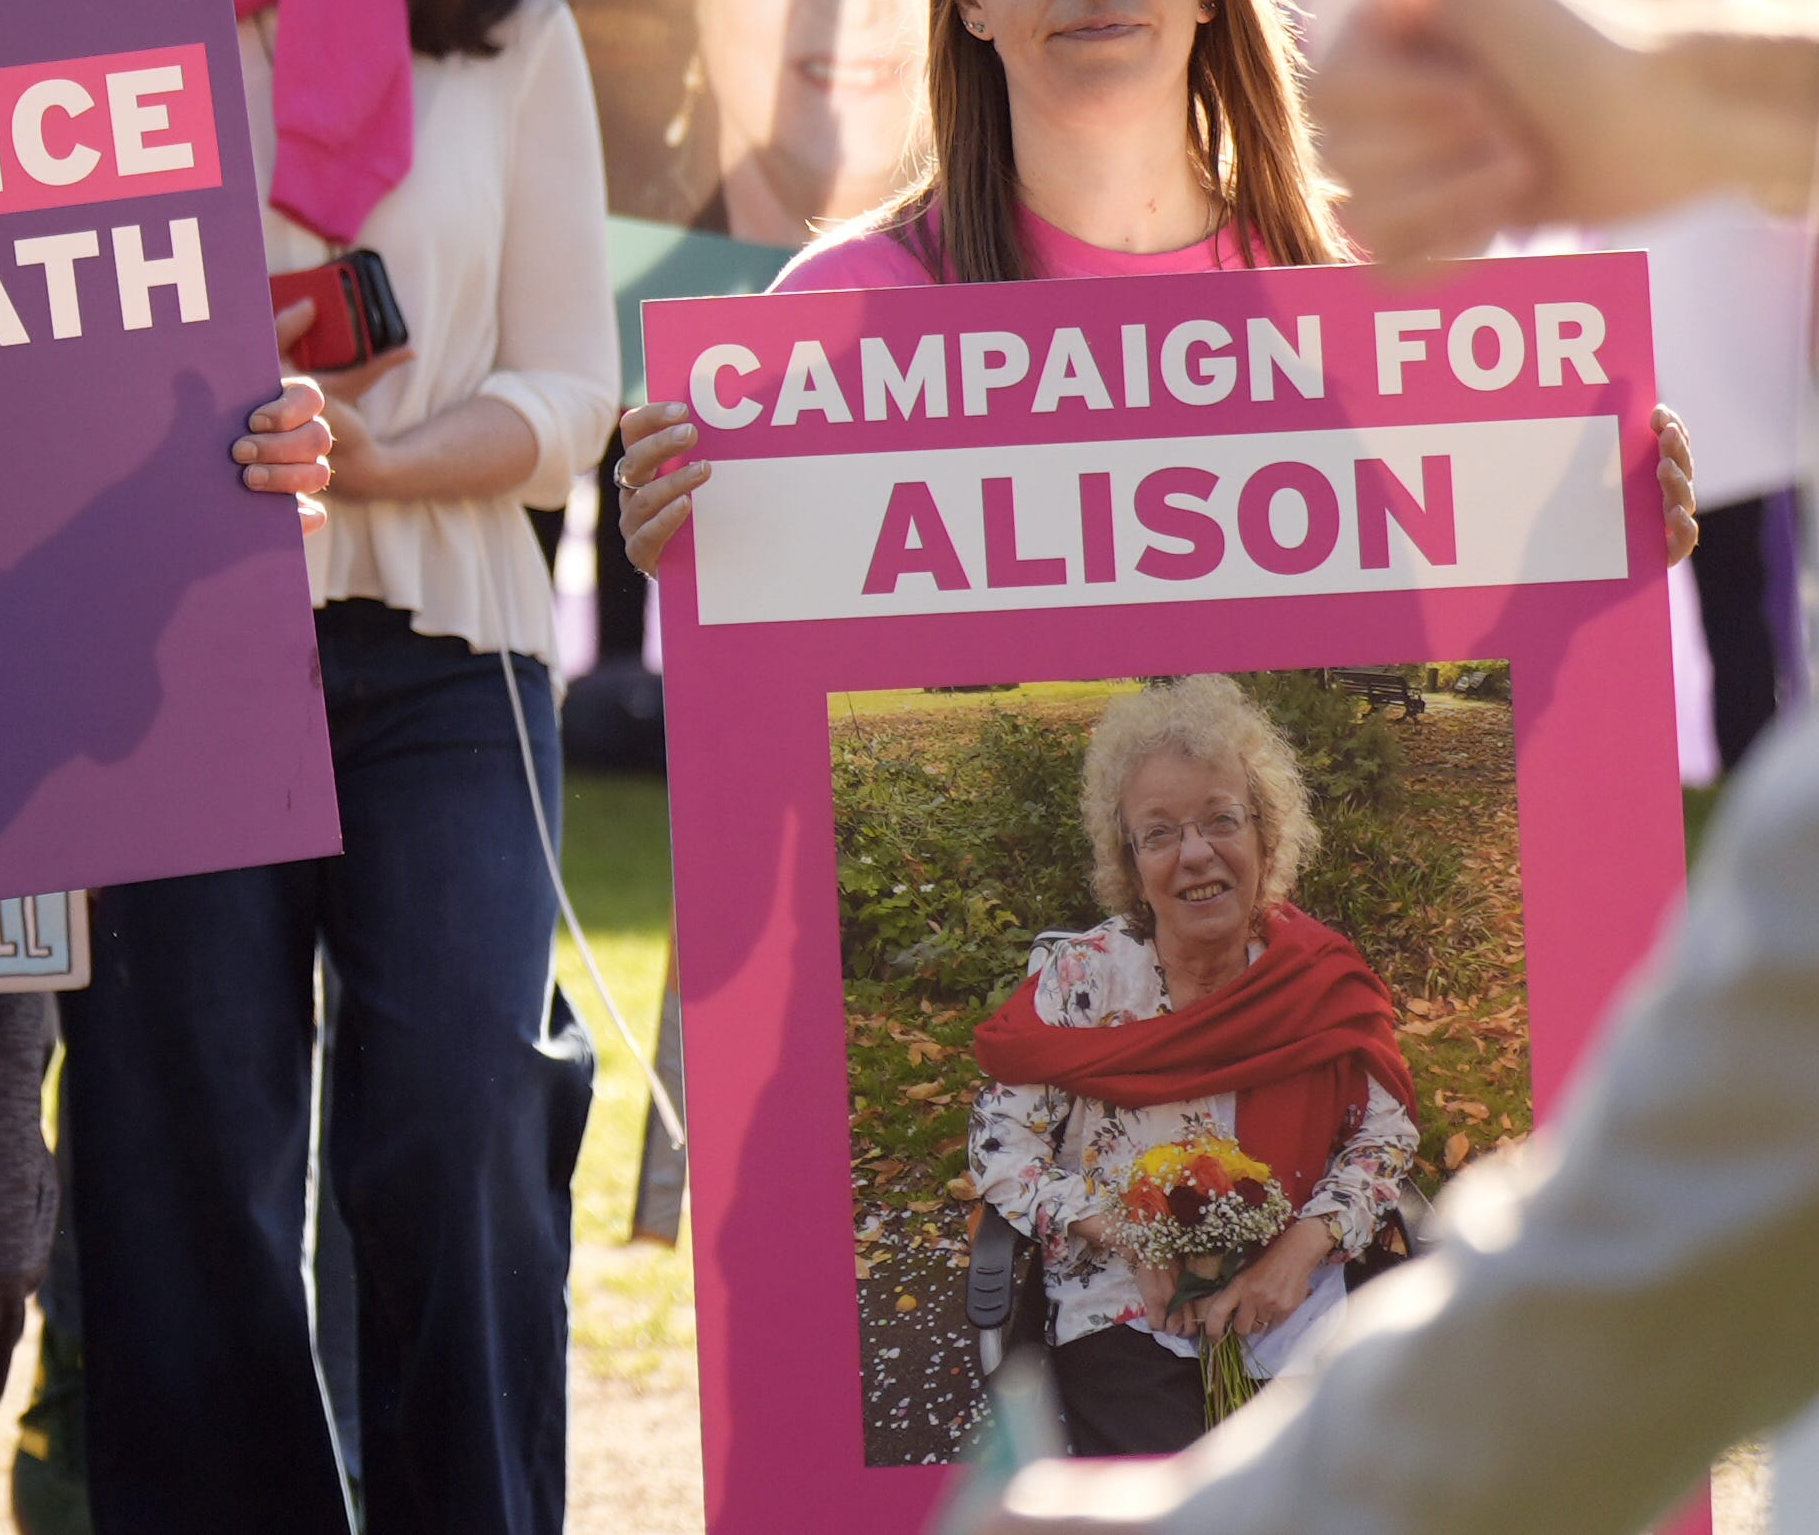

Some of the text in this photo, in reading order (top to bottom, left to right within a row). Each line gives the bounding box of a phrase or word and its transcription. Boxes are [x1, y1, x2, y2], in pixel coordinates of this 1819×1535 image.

[688, 300, 1611, 432] CAMPAIGN FOR
[859, 454, 1459, 596] ALISON
